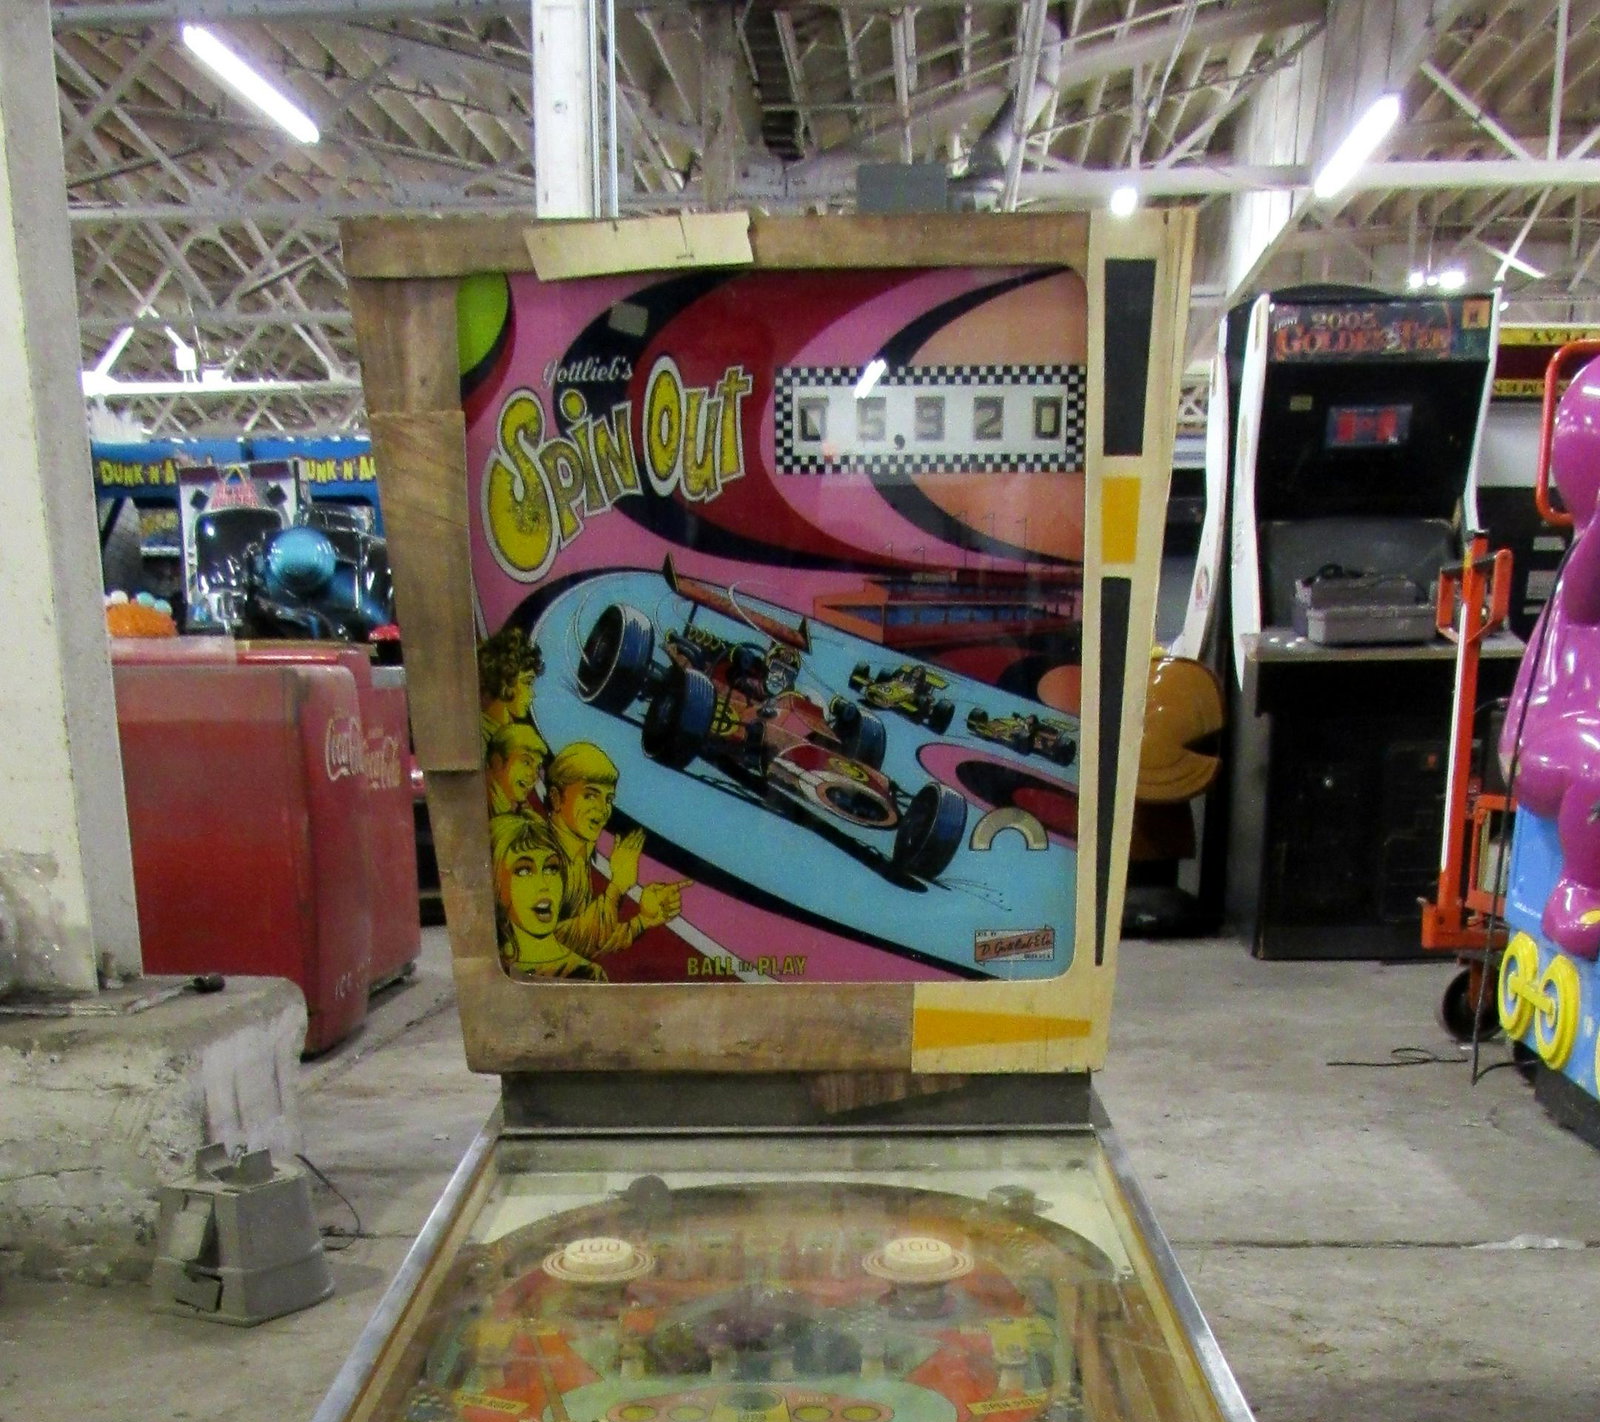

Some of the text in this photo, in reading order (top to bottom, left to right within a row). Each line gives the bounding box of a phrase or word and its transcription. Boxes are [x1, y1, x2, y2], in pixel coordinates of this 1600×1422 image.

[541, 353, 634, 390] Gottlieb's
[686, 956, 735, 977] BALL
[757, 956, 808, 976] PLAY
